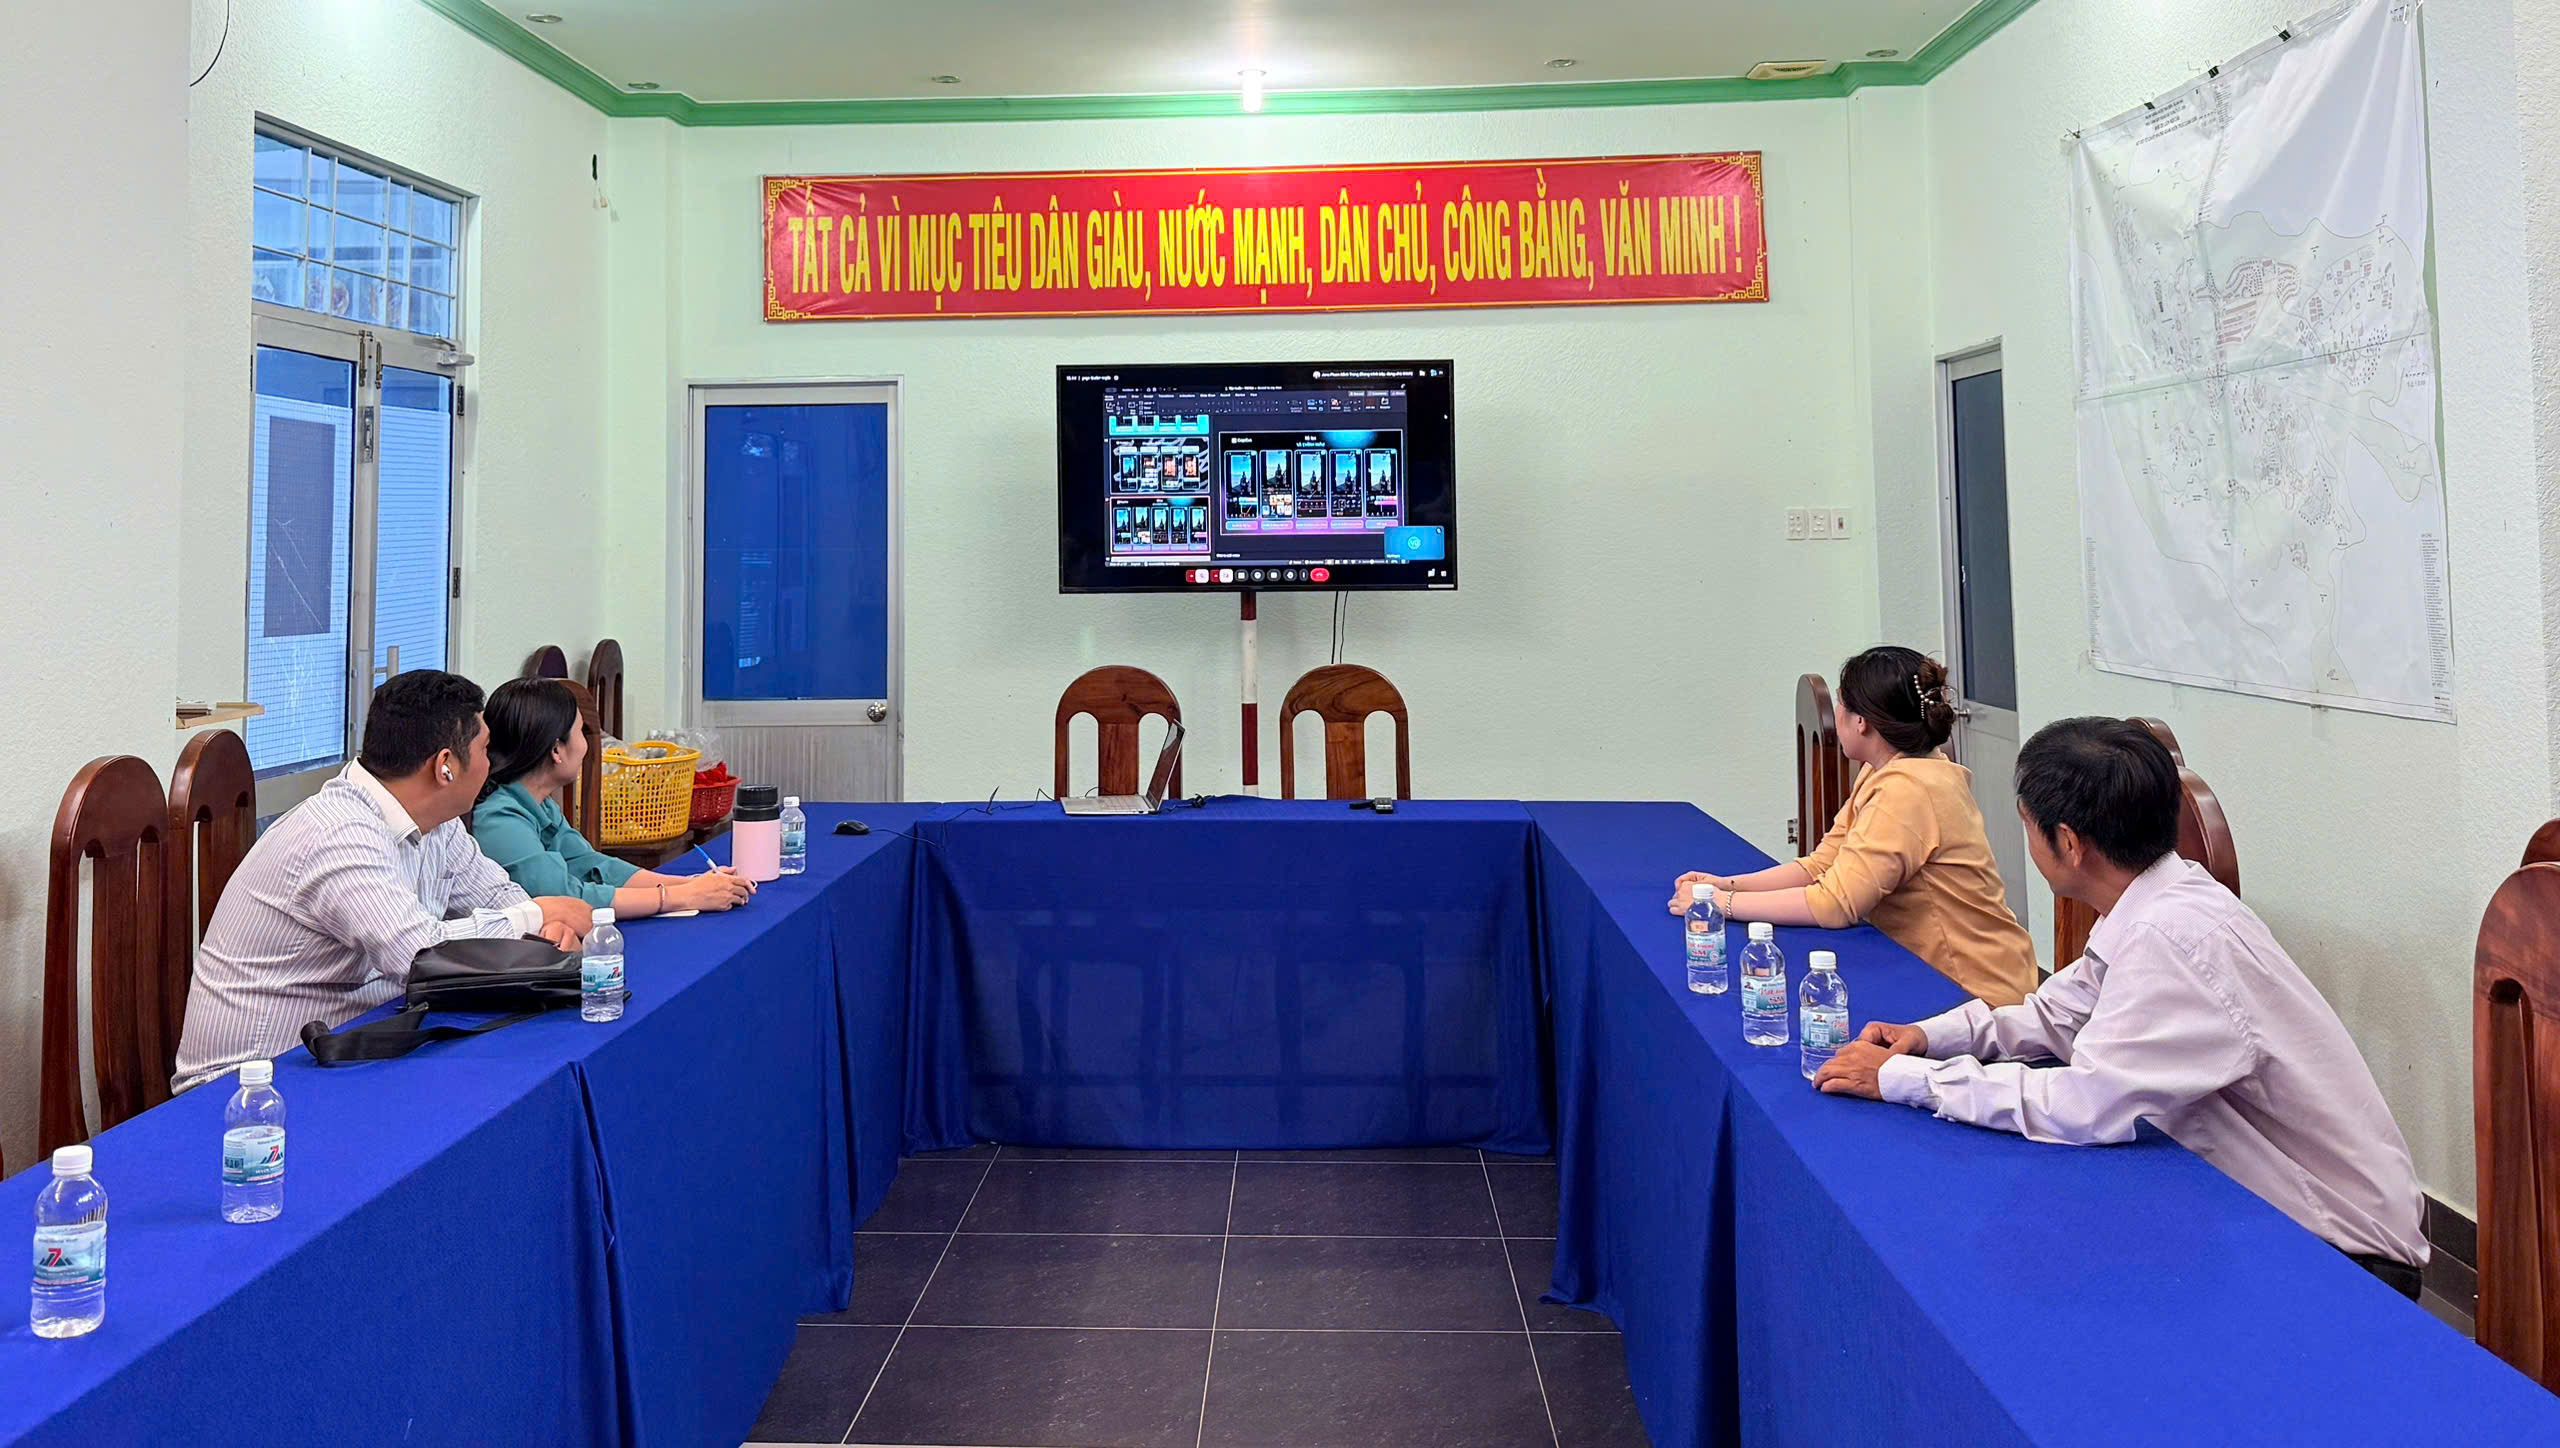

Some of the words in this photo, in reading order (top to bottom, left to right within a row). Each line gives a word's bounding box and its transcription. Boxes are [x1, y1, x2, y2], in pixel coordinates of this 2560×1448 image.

[788, 186, 833, 293] TẤT
[839, 192, 872, 293] CẢ
[877, 195, 901, 292] VÌ
[909, 214, 963, 310] MỤC
[969, 196, 1022, 291] TIÊU
[1030, 195, 1080, 289] DÂN
[1087, 191, 1152, 301] GIÀU,
[1159, 189, 1226, 288] NƯỚC
[1233, 207, 1313, 305] MẠNH,
[1320, 188, 1371, 283] DÂN
[1377, 180, 1437, 294] CHỦ,
[1443, 185, 1512, 281] CÔNG
[1519, 168, 1594, 291] BẰNG,
[1599, 180, 1653, 276] VĂN
[1659, 195, 1727, 274] MINH
[1734, 195, 1743, 273] !
[47, 1247, 63, 1268] 7
